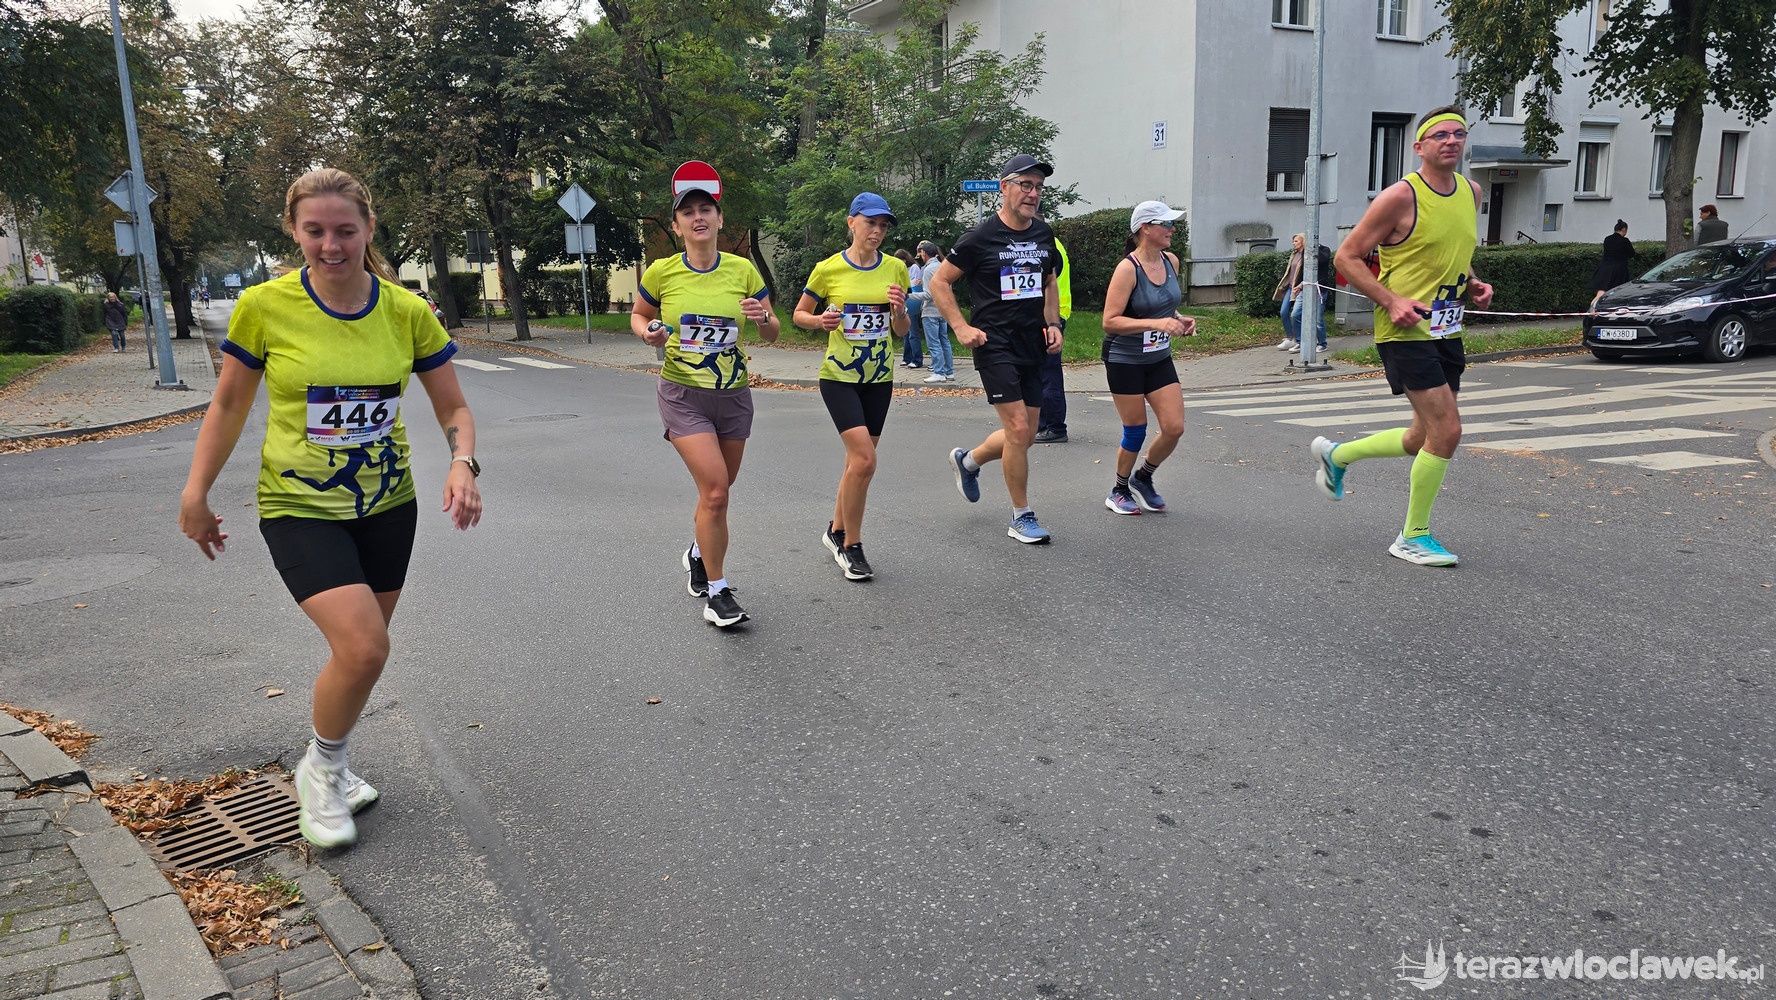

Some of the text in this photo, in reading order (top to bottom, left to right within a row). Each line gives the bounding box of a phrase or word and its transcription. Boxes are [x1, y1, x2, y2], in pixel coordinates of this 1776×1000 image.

[1154, 128, 1164, 142] 31
[998, 249, 1049, 260] RUNMAGEDDON
[1009, 274, 1036, 290] 126
[851, 314, 885, 330] 733
[1438, 307, 1462, 325] 734
[689, 325, 730, 343] 727
[1601, 329, 1611, 338] CW
[321, 401, 389, 429] 446
